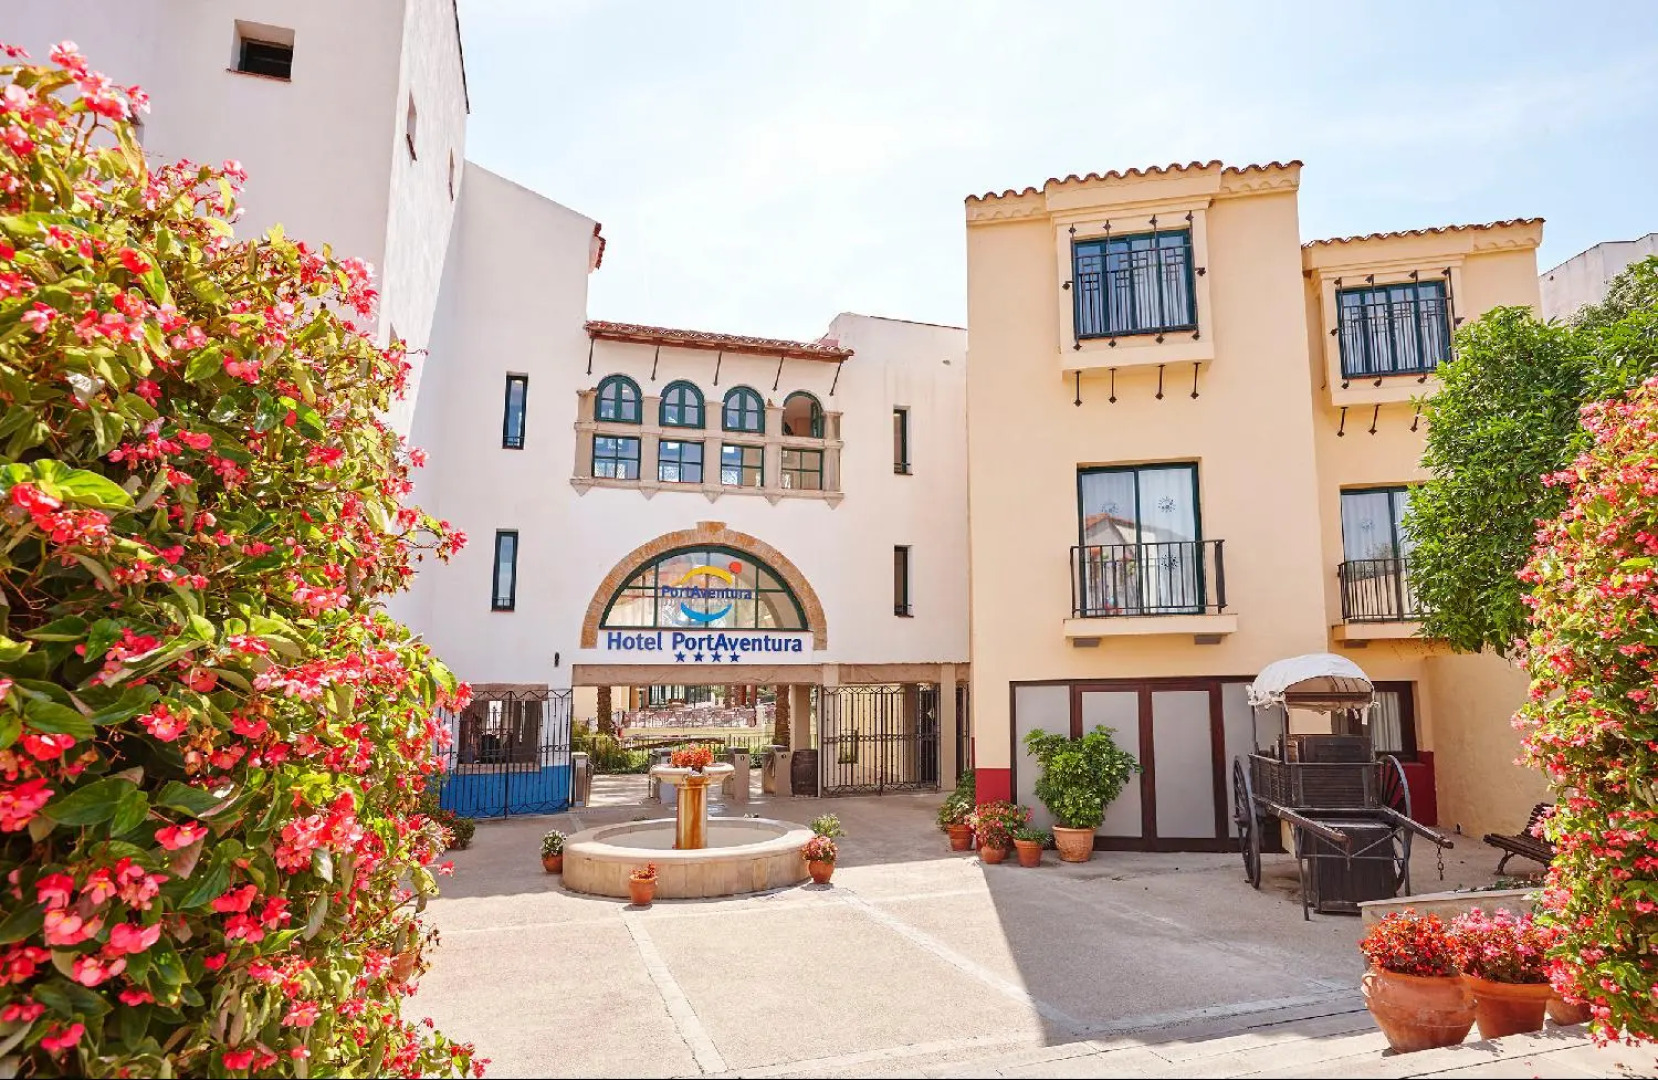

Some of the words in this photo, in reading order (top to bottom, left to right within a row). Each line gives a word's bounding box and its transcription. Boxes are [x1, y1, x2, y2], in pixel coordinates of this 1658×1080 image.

[661, 586, 752, 599] PortAventura
[608, 632, 662, 650] Hotel
[673, 632, 802, 651] PortAventura
